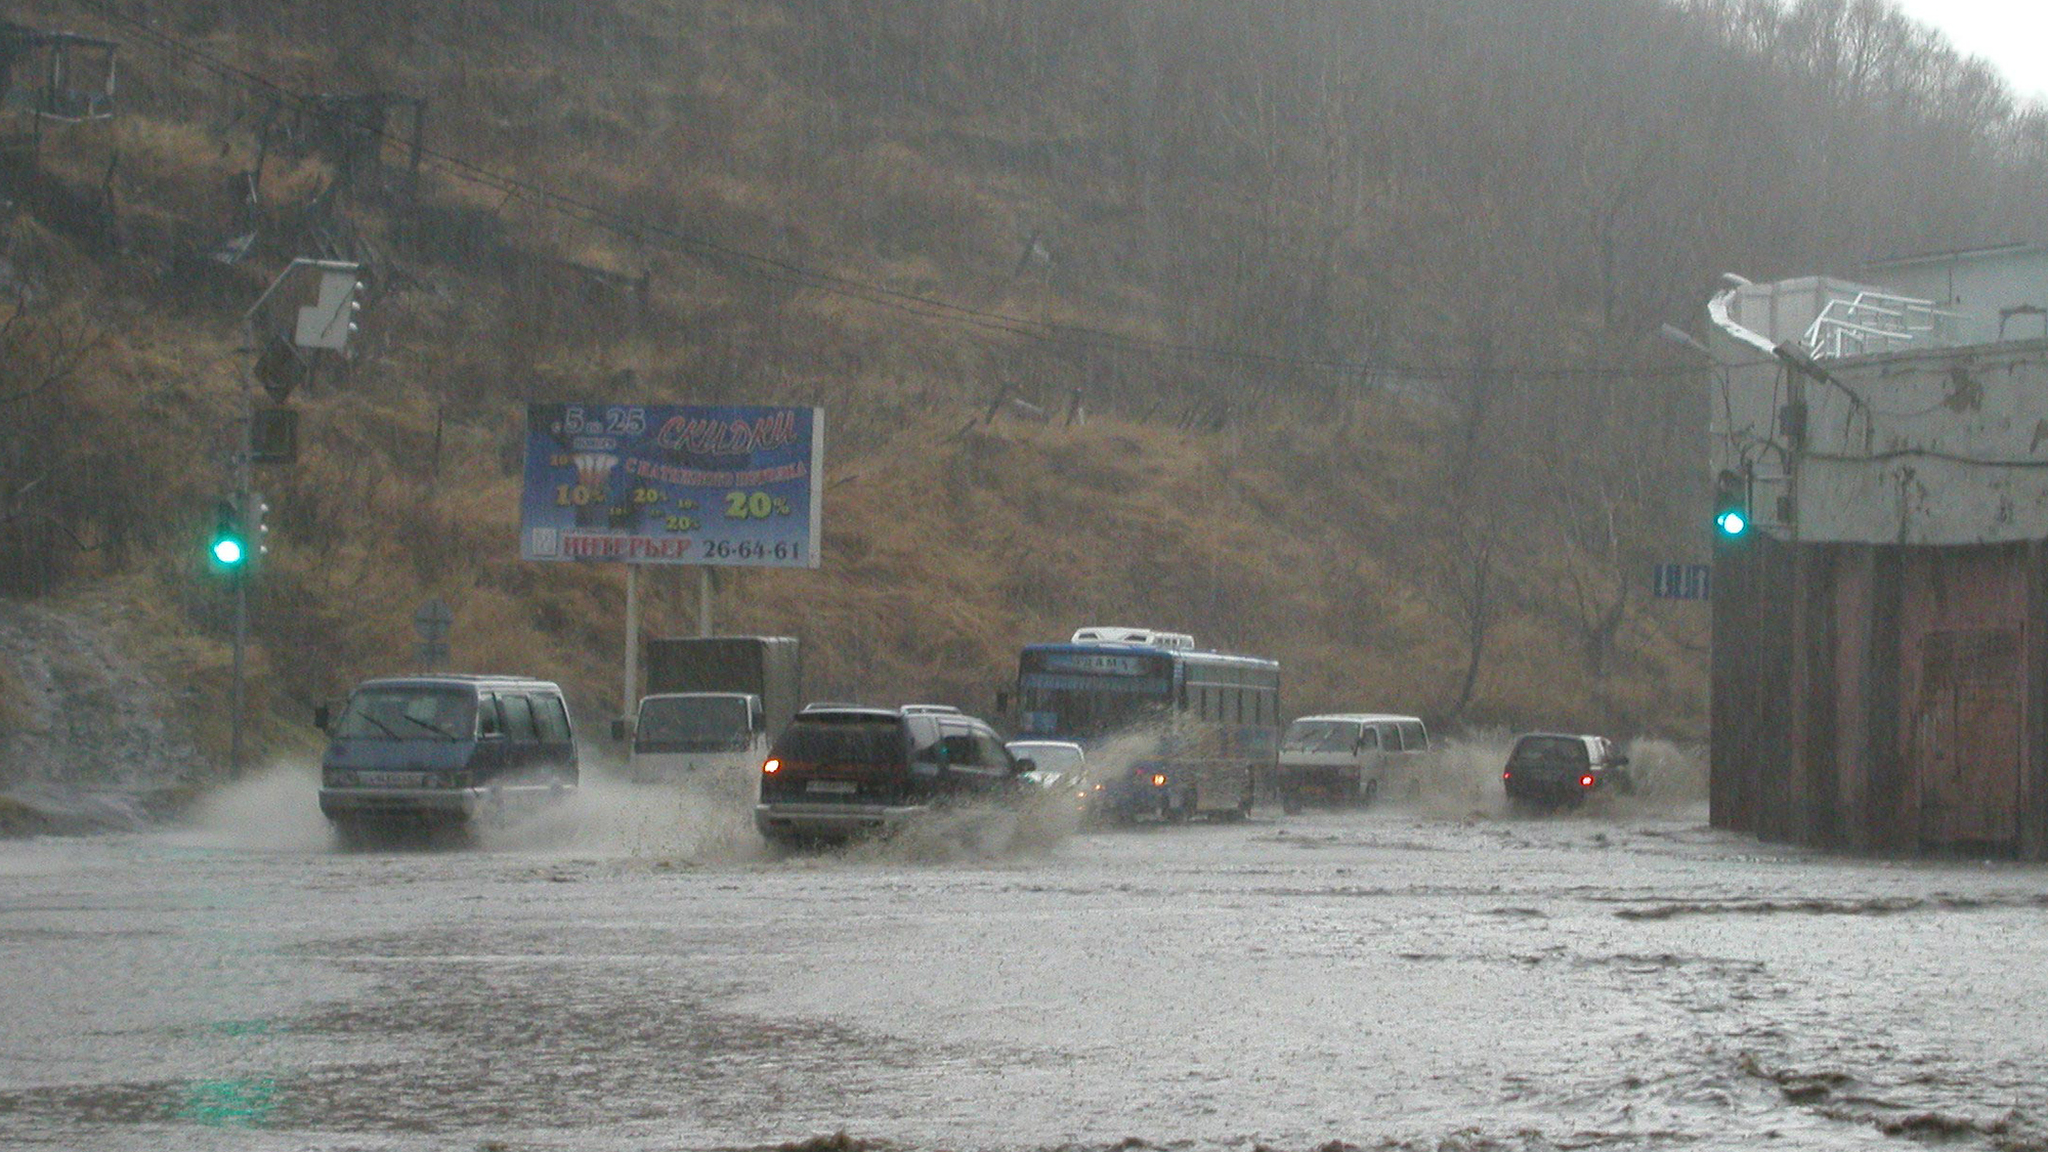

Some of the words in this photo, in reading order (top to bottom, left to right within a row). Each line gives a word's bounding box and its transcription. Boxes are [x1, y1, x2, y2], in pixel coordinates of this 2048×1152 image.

[564, 407, 585, 434] 5
[605, 406, 647, 435] 25
[725, 491, 792, 519] 20%
[562, 535, 693, 559] ИНТЕРЬЕР
[702, 540, 800, 559] 26-64-61
